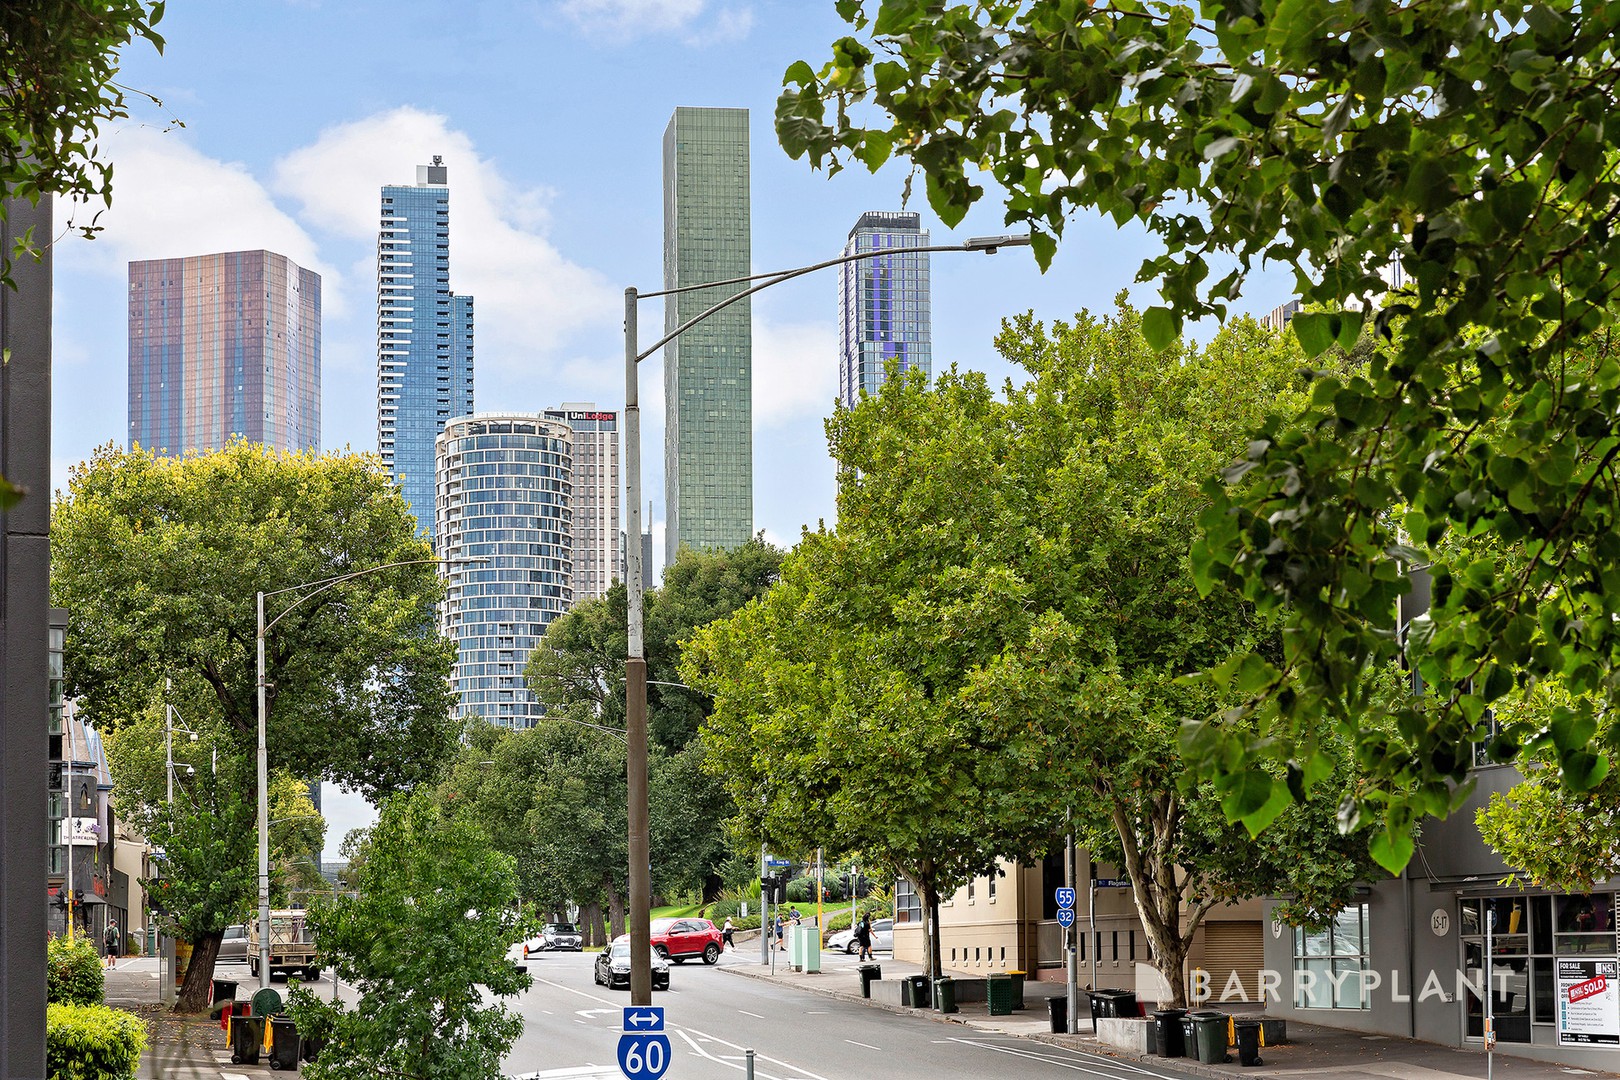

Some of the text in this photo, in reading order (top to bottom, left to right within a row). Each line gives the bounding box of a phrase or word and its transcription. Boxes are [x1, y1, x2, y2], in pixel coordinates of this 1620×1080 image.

[571, 412, 614, 421] UniLodge
[1060, 891, 1072, 904] 55
[1060, 912, 1072, 922] 32
[1433, 916, 1447, 929] 15-17
[1560, 962, 1581, 970] FOR SALE
[1602, 963, 1616, 973] NSL
[1584, 979, 1604, 995] SOLD
[625, 1040, 664, 1074] 60
